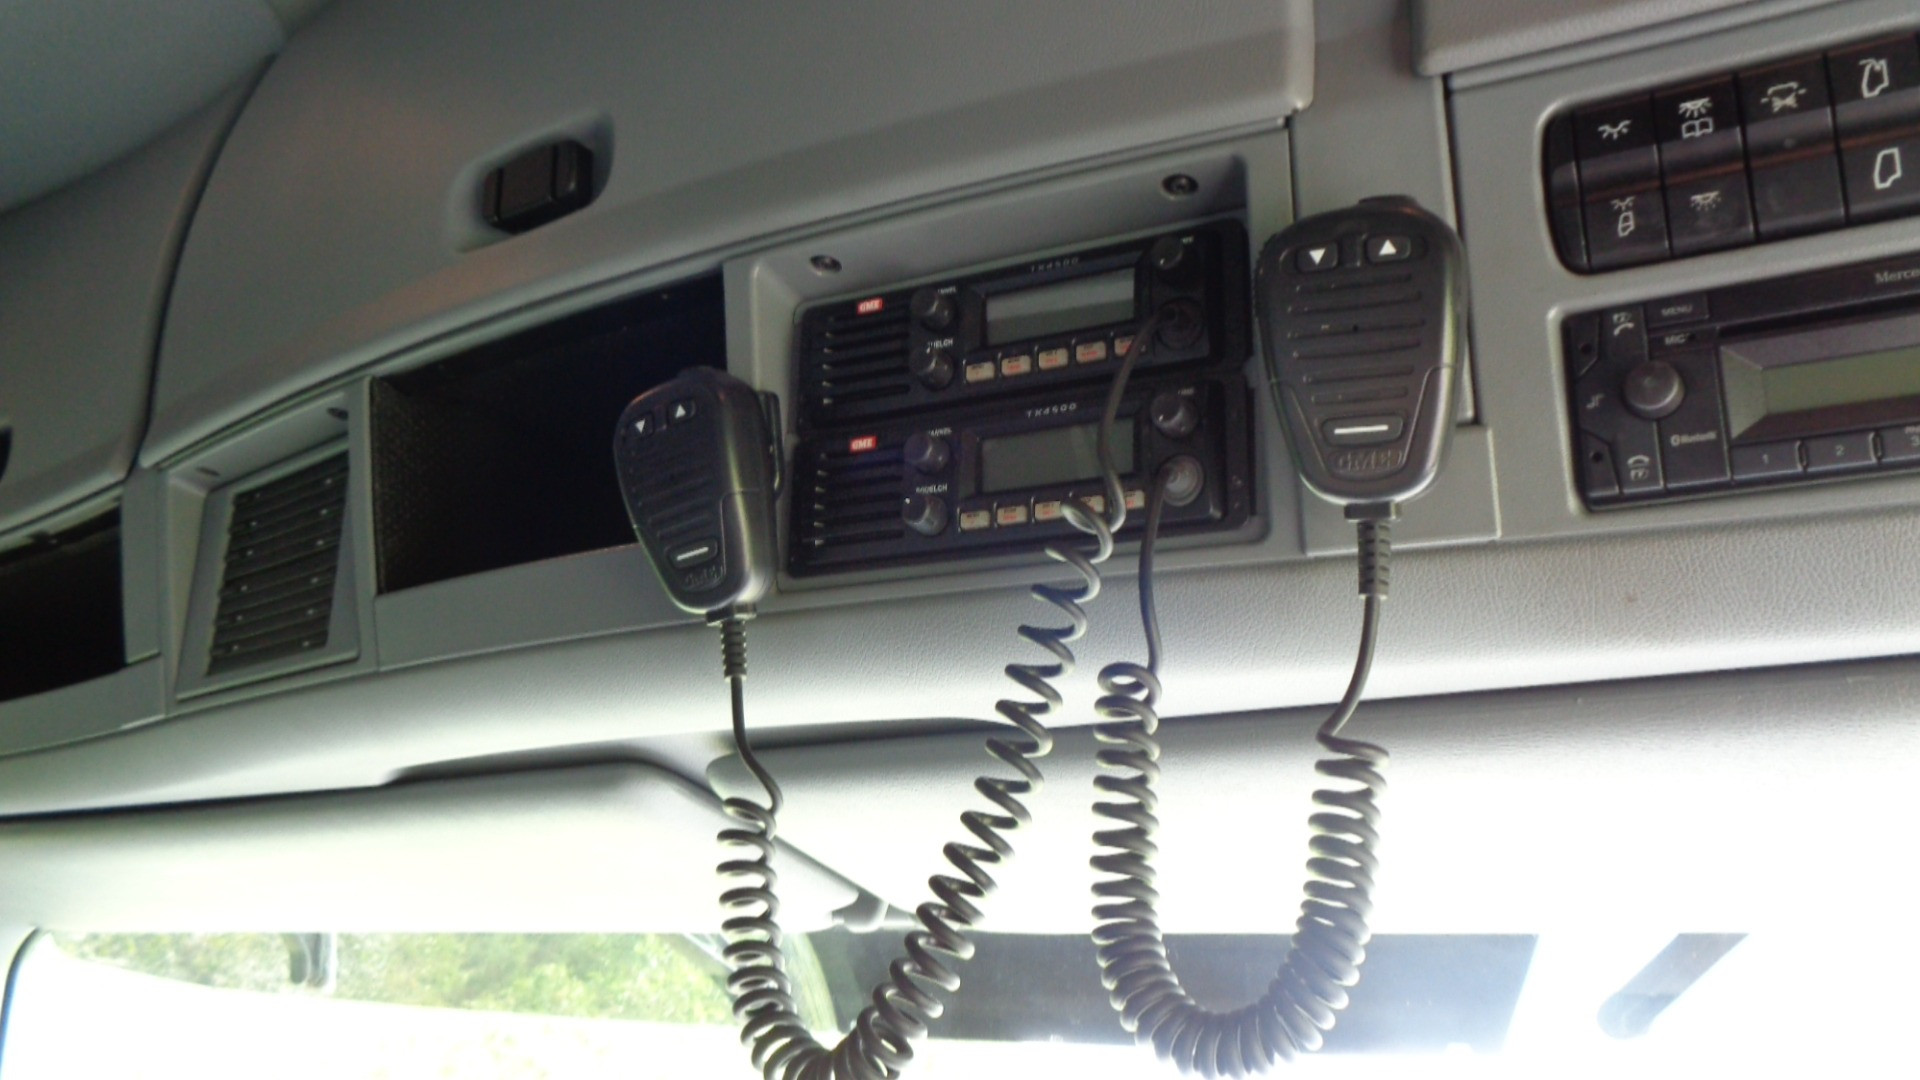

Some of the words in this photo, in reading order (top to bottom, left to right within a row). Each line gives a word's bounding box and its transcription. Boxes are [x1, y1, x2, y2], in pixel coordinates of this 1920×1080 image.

[1875, 268, 1920, 284] Merce
[1661, 304, 1693, 316] MENU
[1665, 334, 1686, 345] MIC
[1026, 402, 1077, 418] TX4500
[852, 437, 874, 451] GME
[1835, 445, 1845, 455] 2
